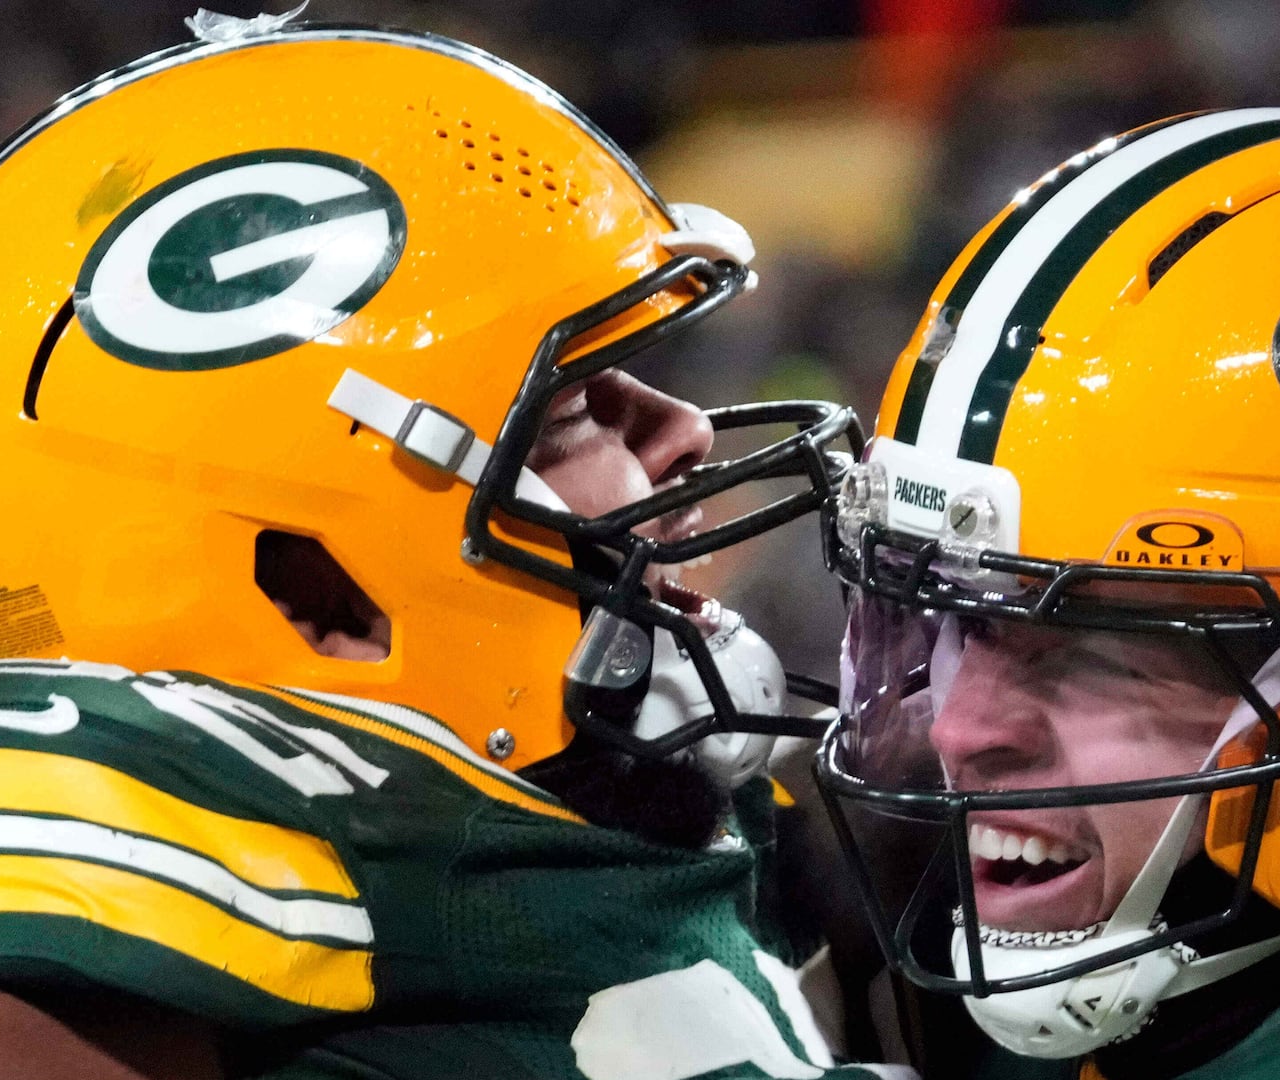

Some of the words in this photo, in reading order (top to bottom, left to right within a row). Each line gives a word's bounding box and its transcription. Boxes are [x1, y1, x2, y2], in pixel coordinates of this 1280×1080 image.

[89, 160, 391, 354] G
[894, 475, 947, 513] PACKERS
[1116, 550, 1233, 567] OAKLEY
